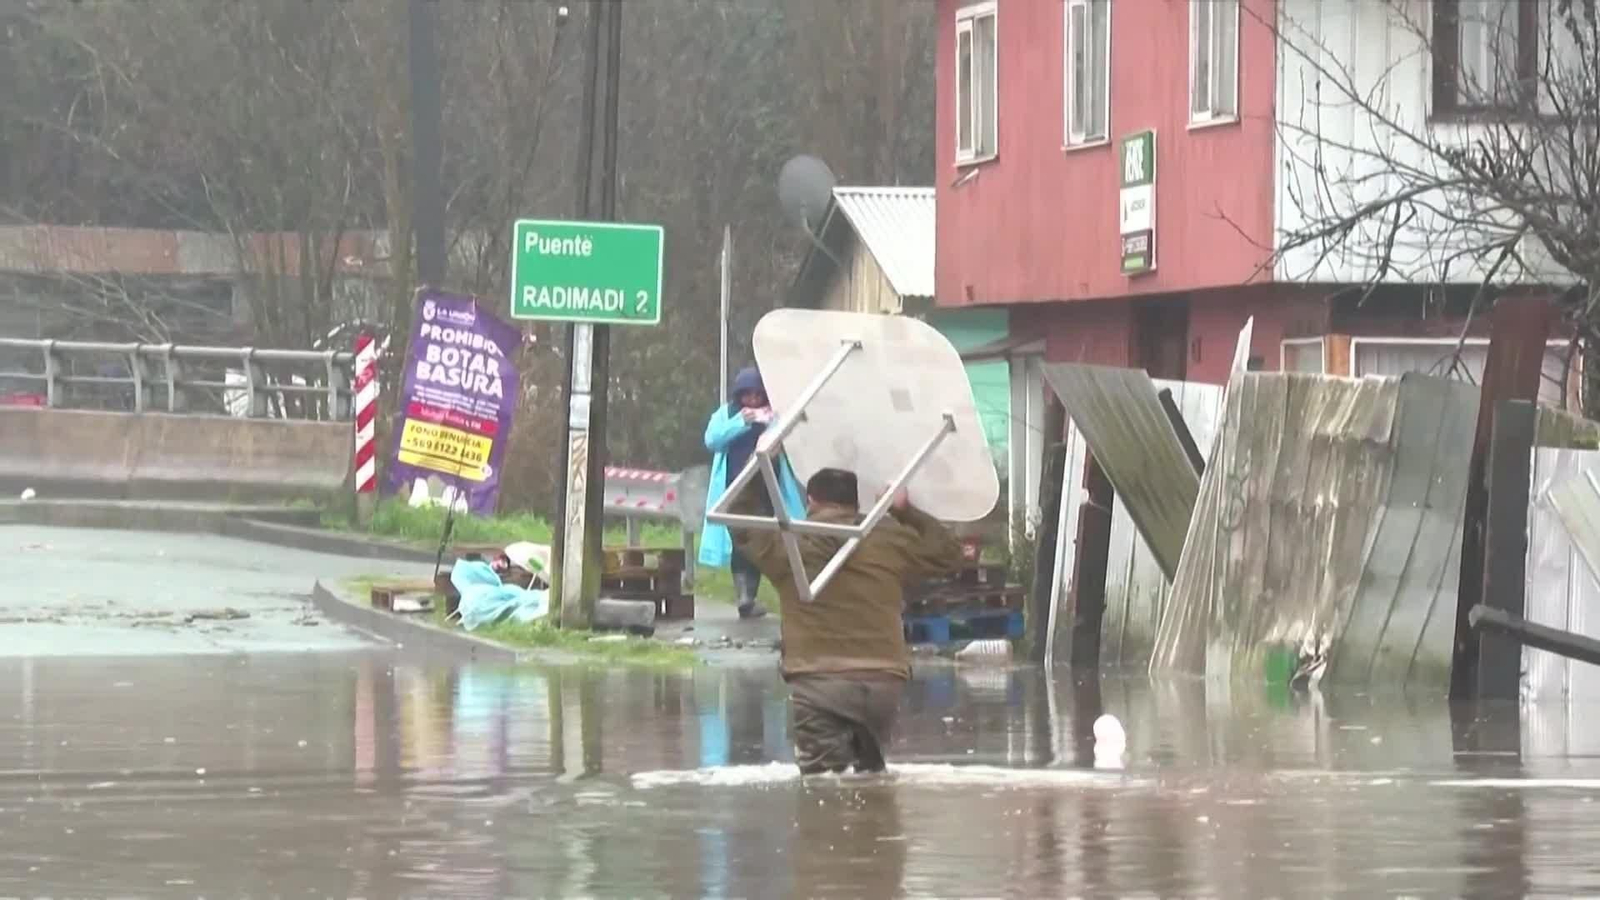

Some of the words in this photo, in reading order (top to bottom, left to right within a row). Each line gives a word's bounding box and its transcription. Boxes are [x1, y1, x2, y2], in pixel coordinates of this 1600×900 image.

[525, 231, 593, 256] Puente
[522, 285, 624, 311] RADIMADI
[636, 289, 649, 313] 2
[426, 343, 500, 378] BOTAR
[416, 360, 503, 399] BASURA
